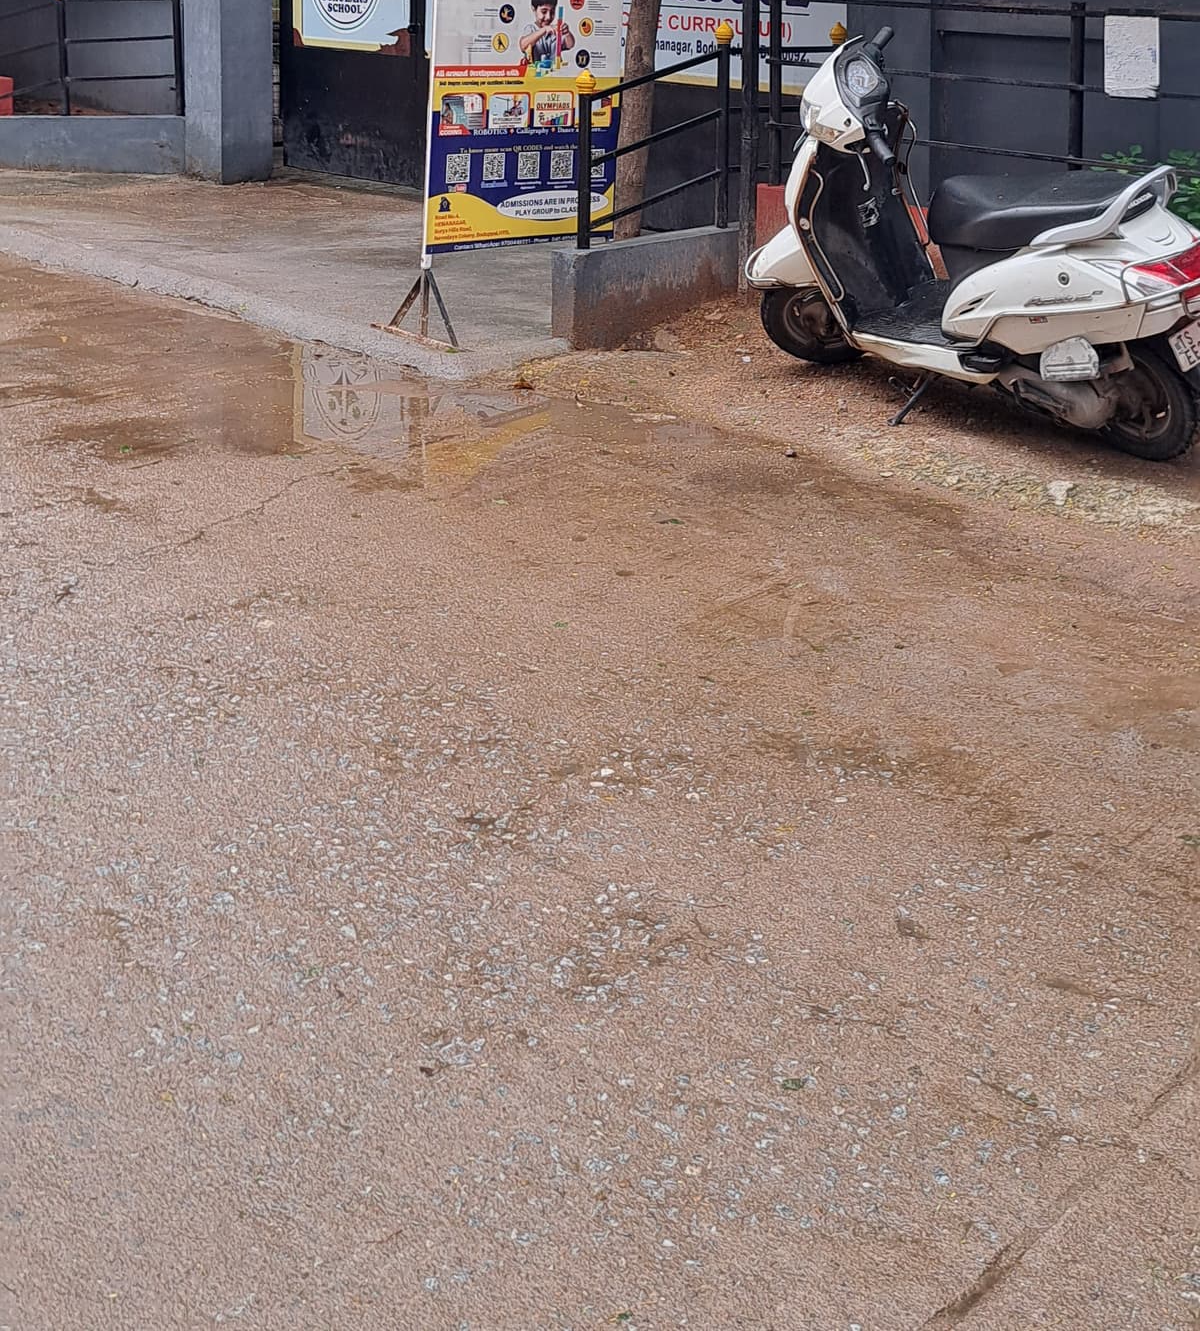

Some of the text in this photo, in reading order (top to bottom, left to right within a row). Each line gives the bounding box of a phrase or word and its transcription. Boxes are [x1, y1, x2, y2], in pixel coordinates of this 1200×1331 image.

[328, 3, 362, 14] SCHOOL
[536, 102, 570, 110] OLYMPIADS
[473, 128, 508, 136] ROBOTICS
[516, 127, 549, 136] Calligraphy
[501, 197, 543, 208] ADMISSIONS
[544, 196, 557, 206] ARE
[558, 196, 566, 206] IN
[515, 207, 531, 216] PLAY
[532, 206, 554, 216] GROUP
[1176, 330, 1194, 349] TS
